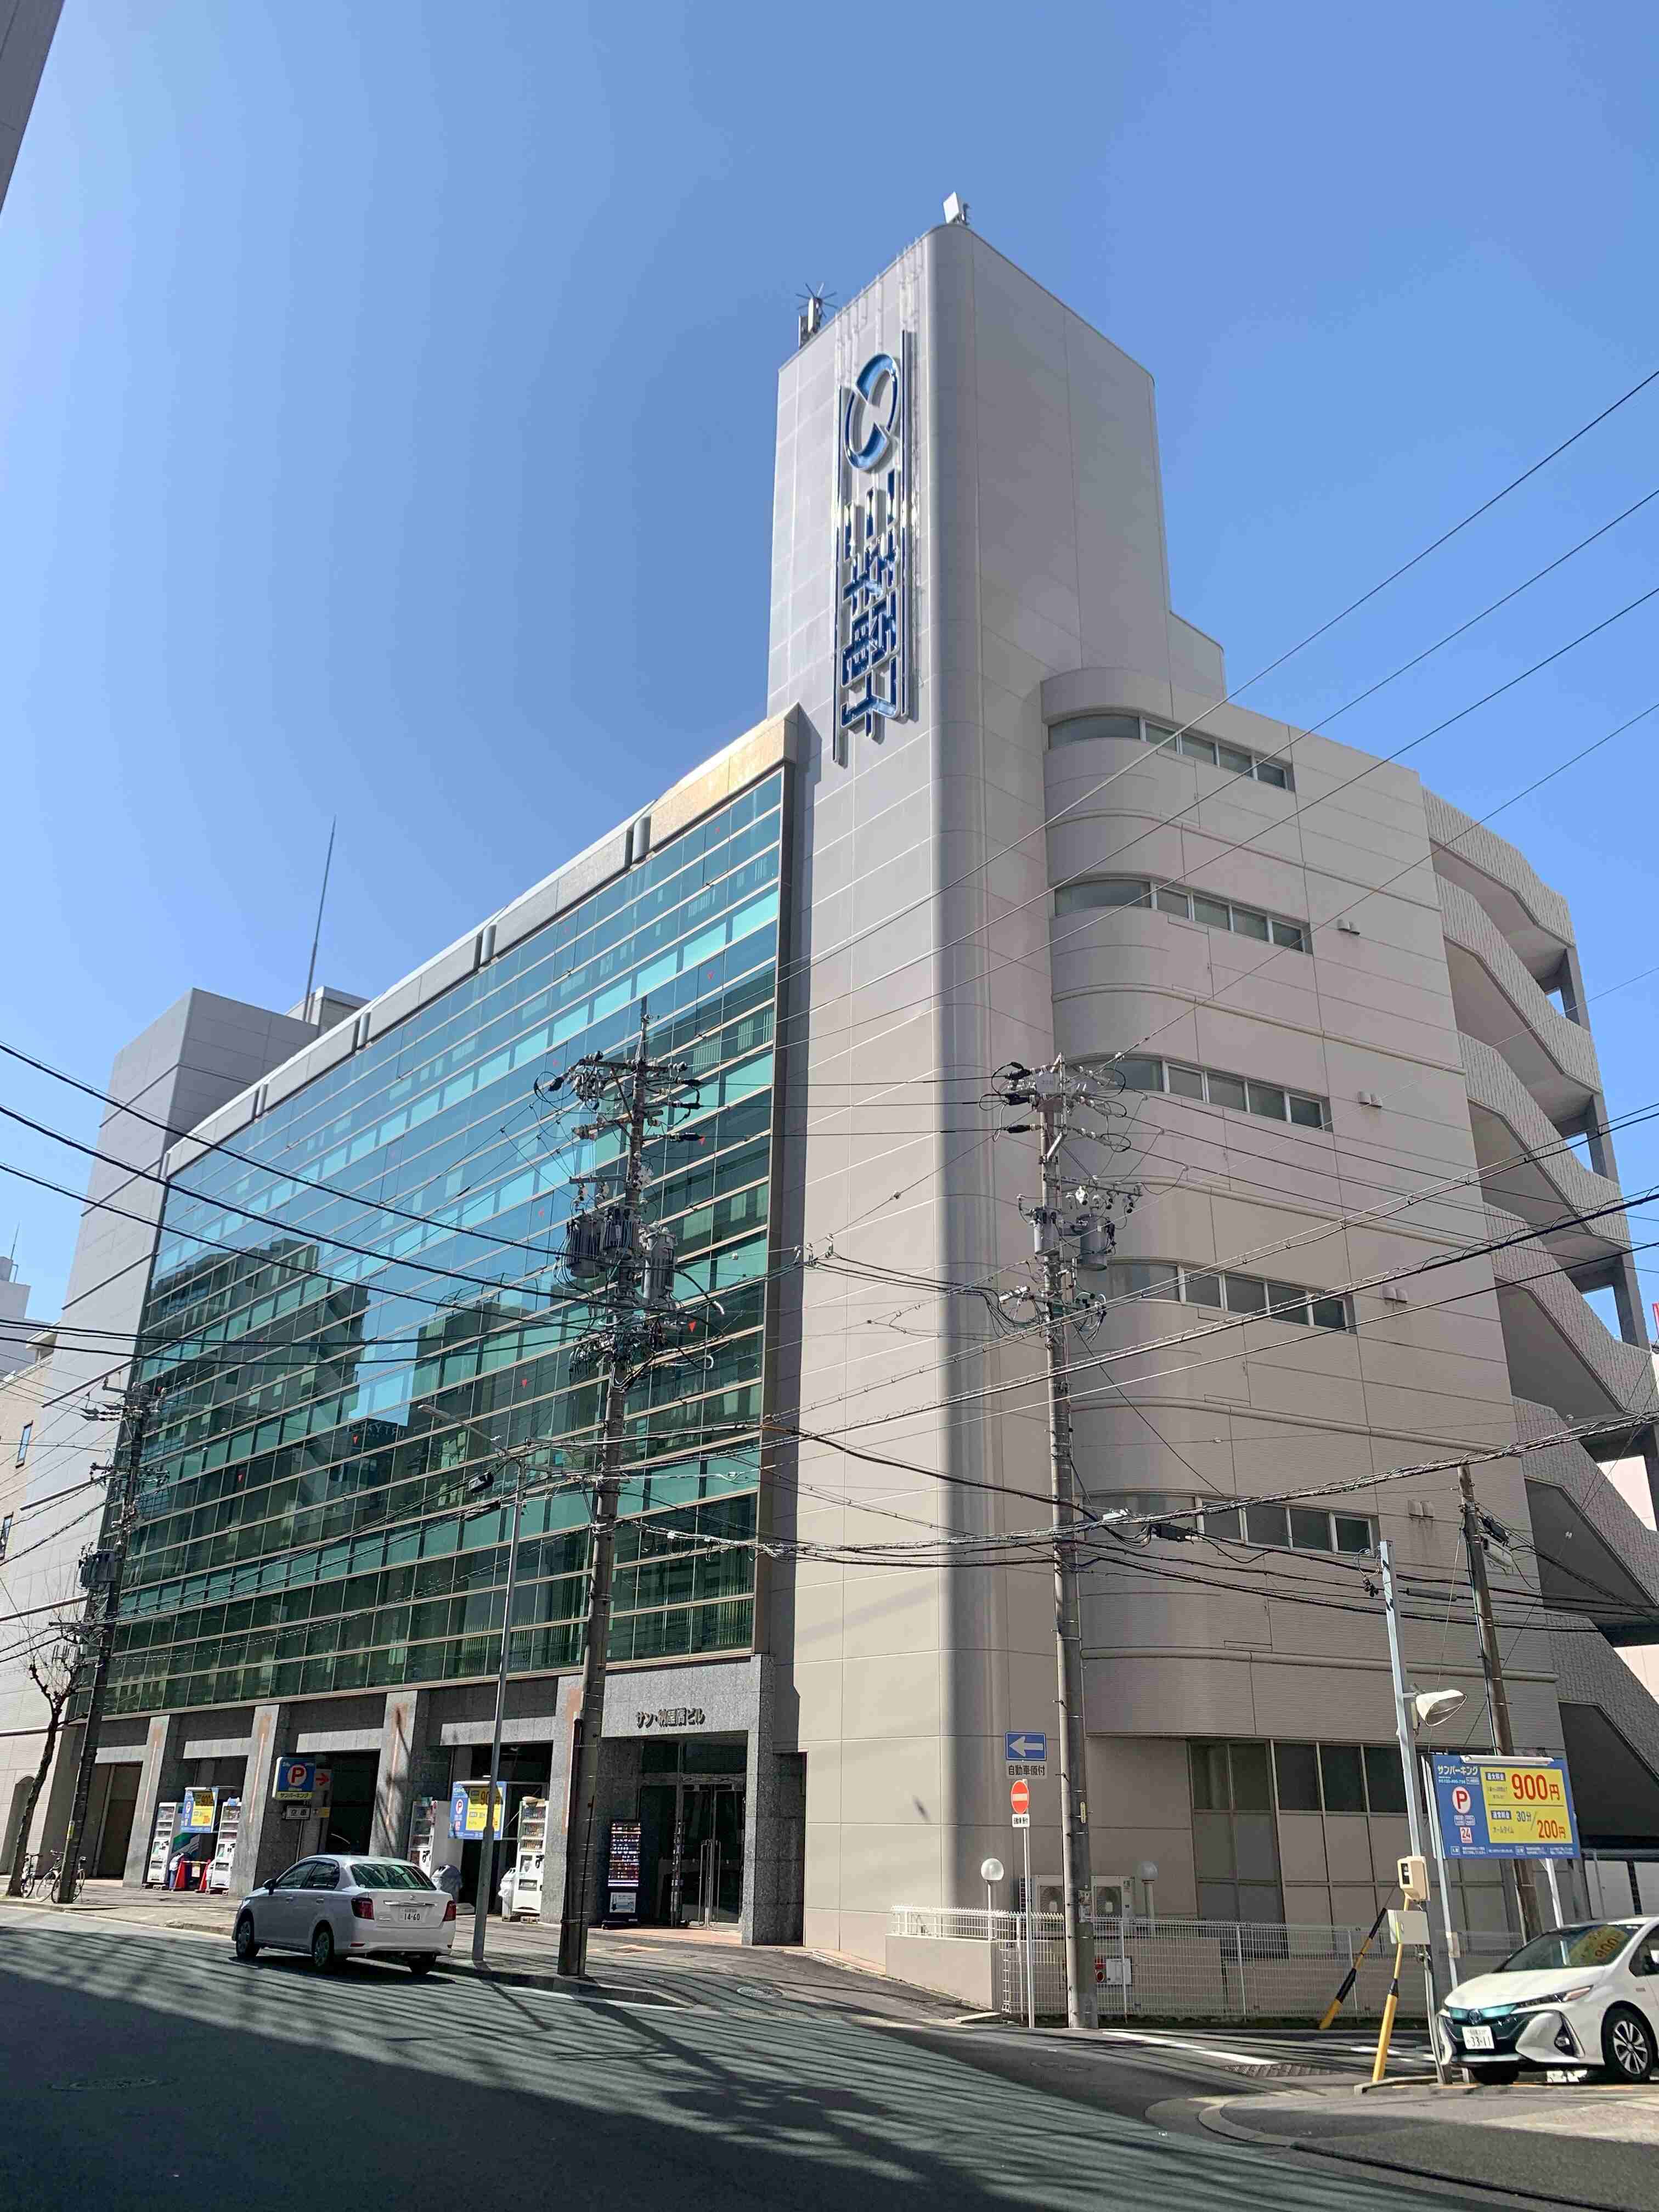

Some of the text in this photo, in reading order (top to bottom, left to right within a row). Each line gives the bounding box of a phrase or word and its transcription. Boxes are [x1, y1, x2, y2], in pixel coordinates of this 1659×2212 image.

[290, 1767, 305, 1783] P
[1437, 1765, 1478, 1775] サンパーキング
[1511, 1773, 1560, 1800] 900円
[1456, 1790, 1468, 1809] P
[1461, 1828, 1471, 1838] 24
[1537, 1819, 1566, 1839] 200円
